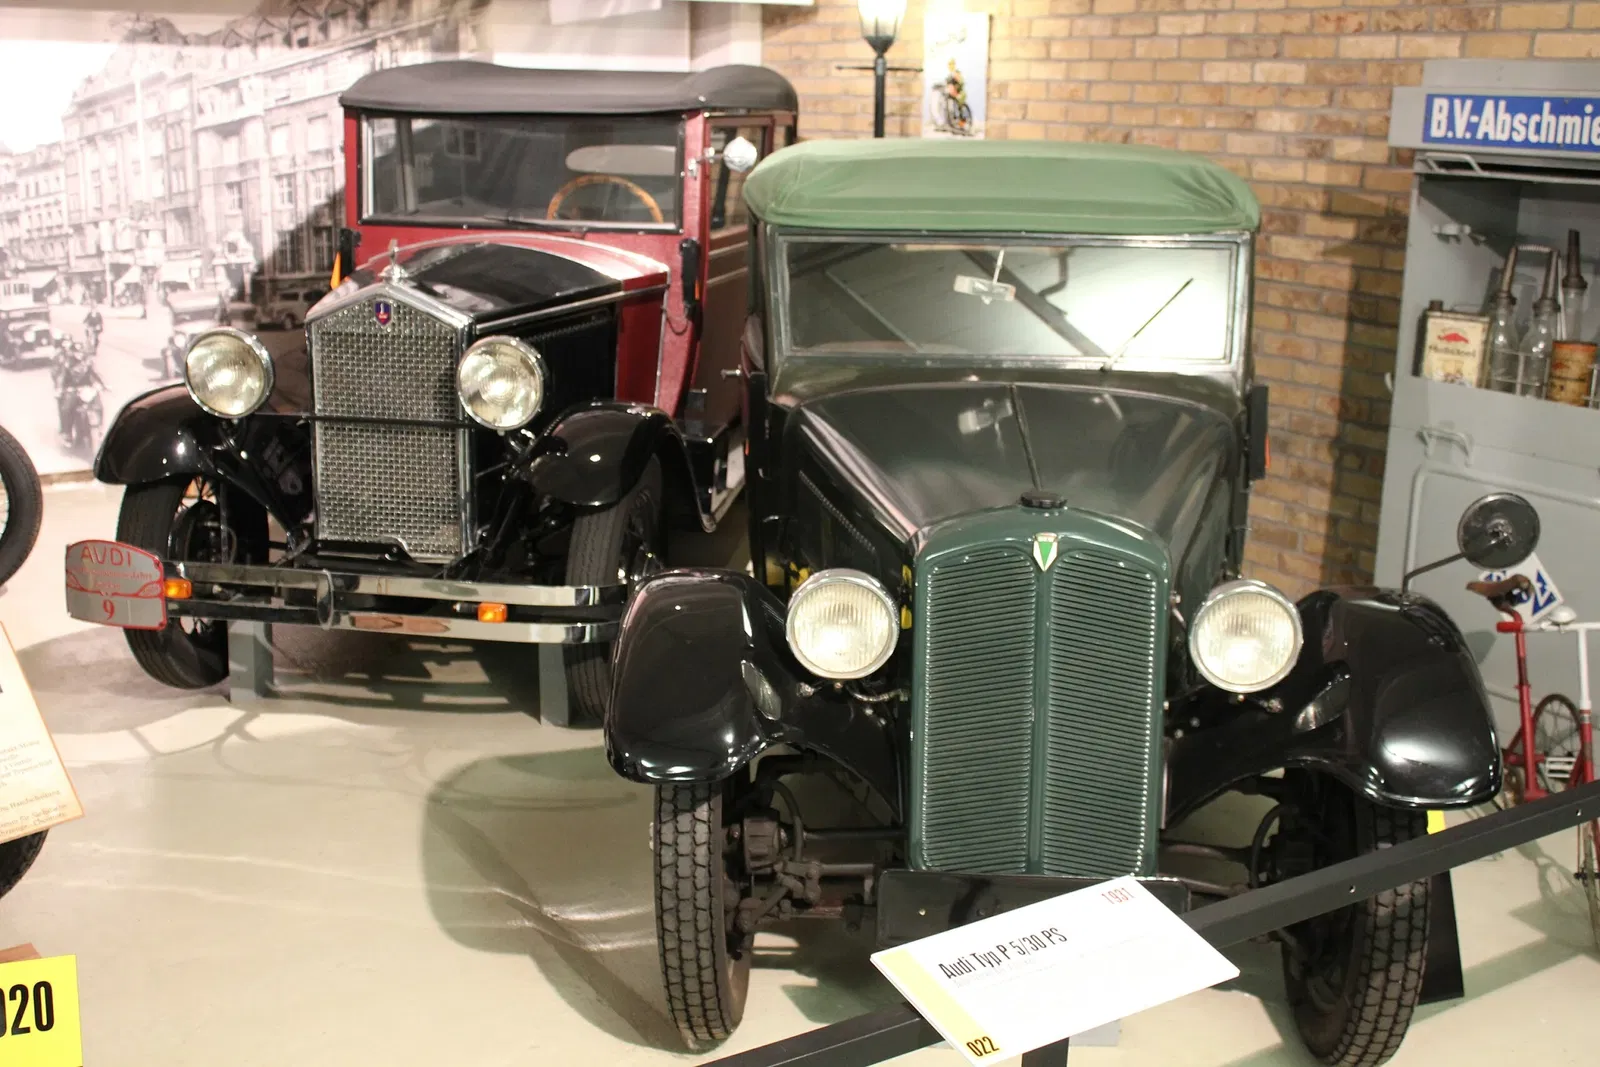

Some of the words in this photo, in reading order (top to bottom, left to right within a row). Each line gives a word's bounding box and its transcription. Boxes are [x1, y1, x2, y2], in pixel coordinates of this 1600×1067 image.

[103, 599, 115, 620] 9
[1101, 887, 1135, 905] 1931
[938, 955, 976, 980] Audi
[971, 951, 1003, 969] Typ
[996, 944, 1011, 960] P
[1009, 934, 1047, 956] 5/30
[1041, 927, 1067, 945] PS
[966, 1036, 999, 1058] 022
